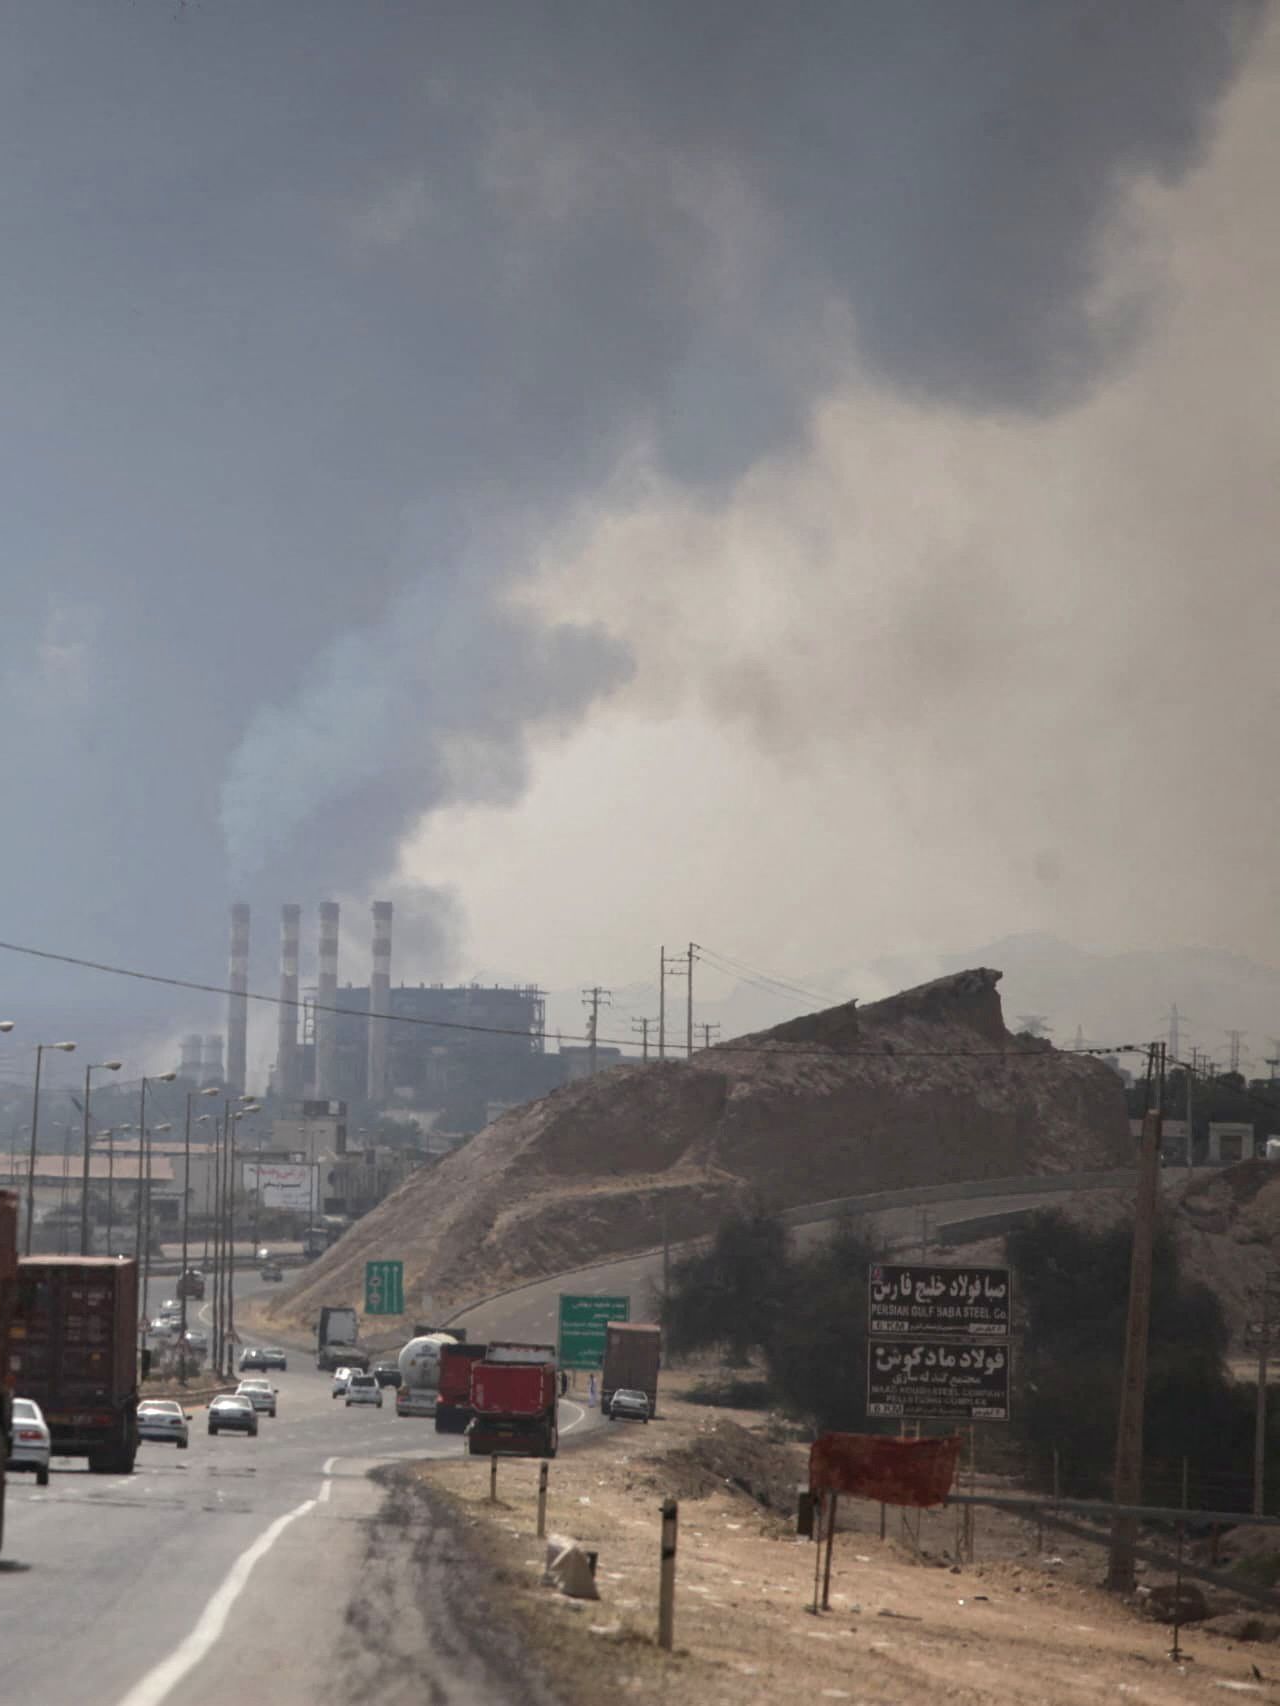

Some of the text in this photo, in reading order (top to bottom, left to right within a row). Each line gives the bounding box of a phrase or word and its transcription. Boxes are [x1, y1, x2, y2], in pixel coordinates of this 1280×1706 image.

[873, 1271, 1007, 1305] صبا فولاد خلیج فارس
[871, 1303, 910, 1316] PERSIAN
[911, 1305, 935, 1317] GULF
[936, 1305, 962, 1318] SABA
[963, 1306, 991, 1319] STEEL
[959, 1346, 1005, 1375] فولاد
